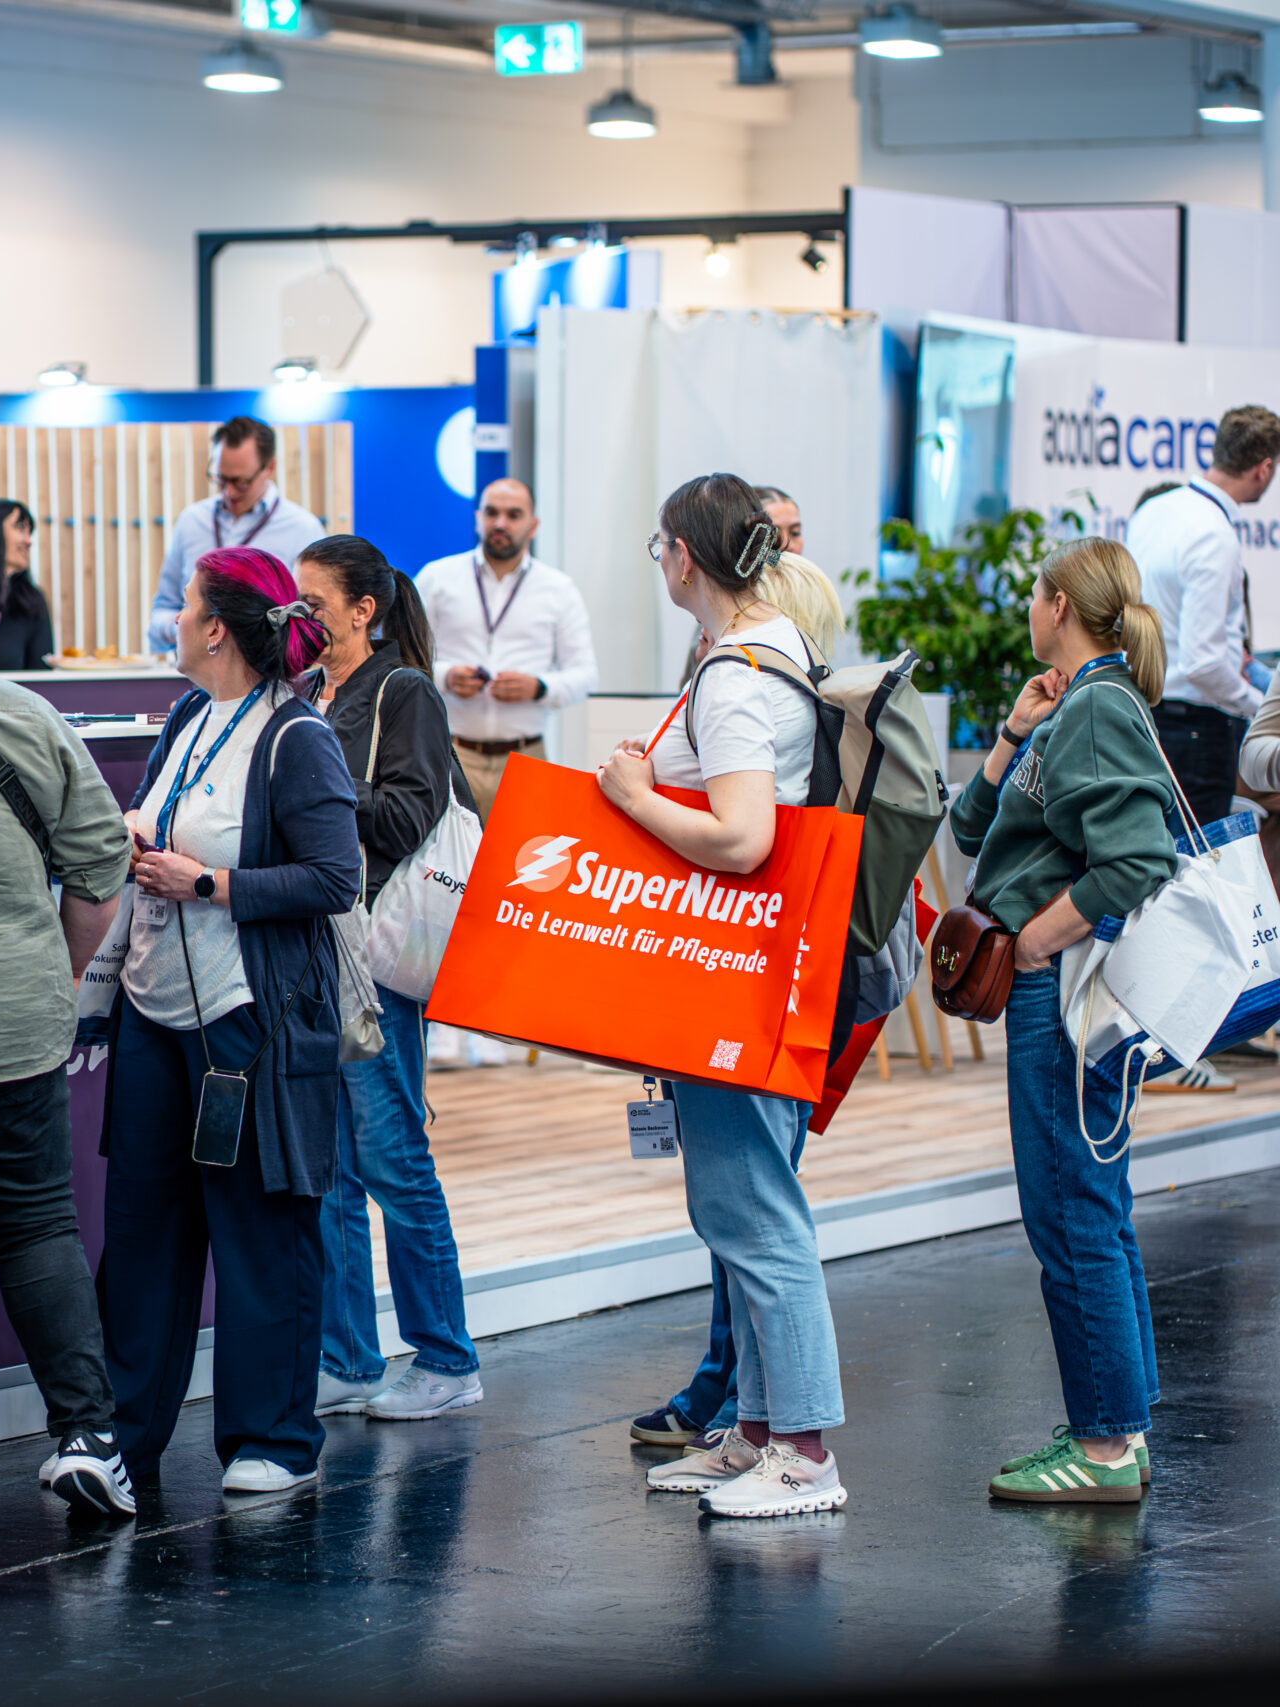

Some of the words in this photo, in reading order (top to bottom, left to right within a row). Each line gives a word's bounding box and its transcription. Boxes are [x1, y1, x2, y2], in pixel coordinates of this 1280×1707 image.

[423, 866, 467, 895] 7days
[568, 851, 783, 928] SuperNurse
[495, 900, 534, 929] Die
[537, 911, 628, 948] Lernwelt
[631, 929, 664, 954] für
[666, 936, 767, 974] Pflegende
